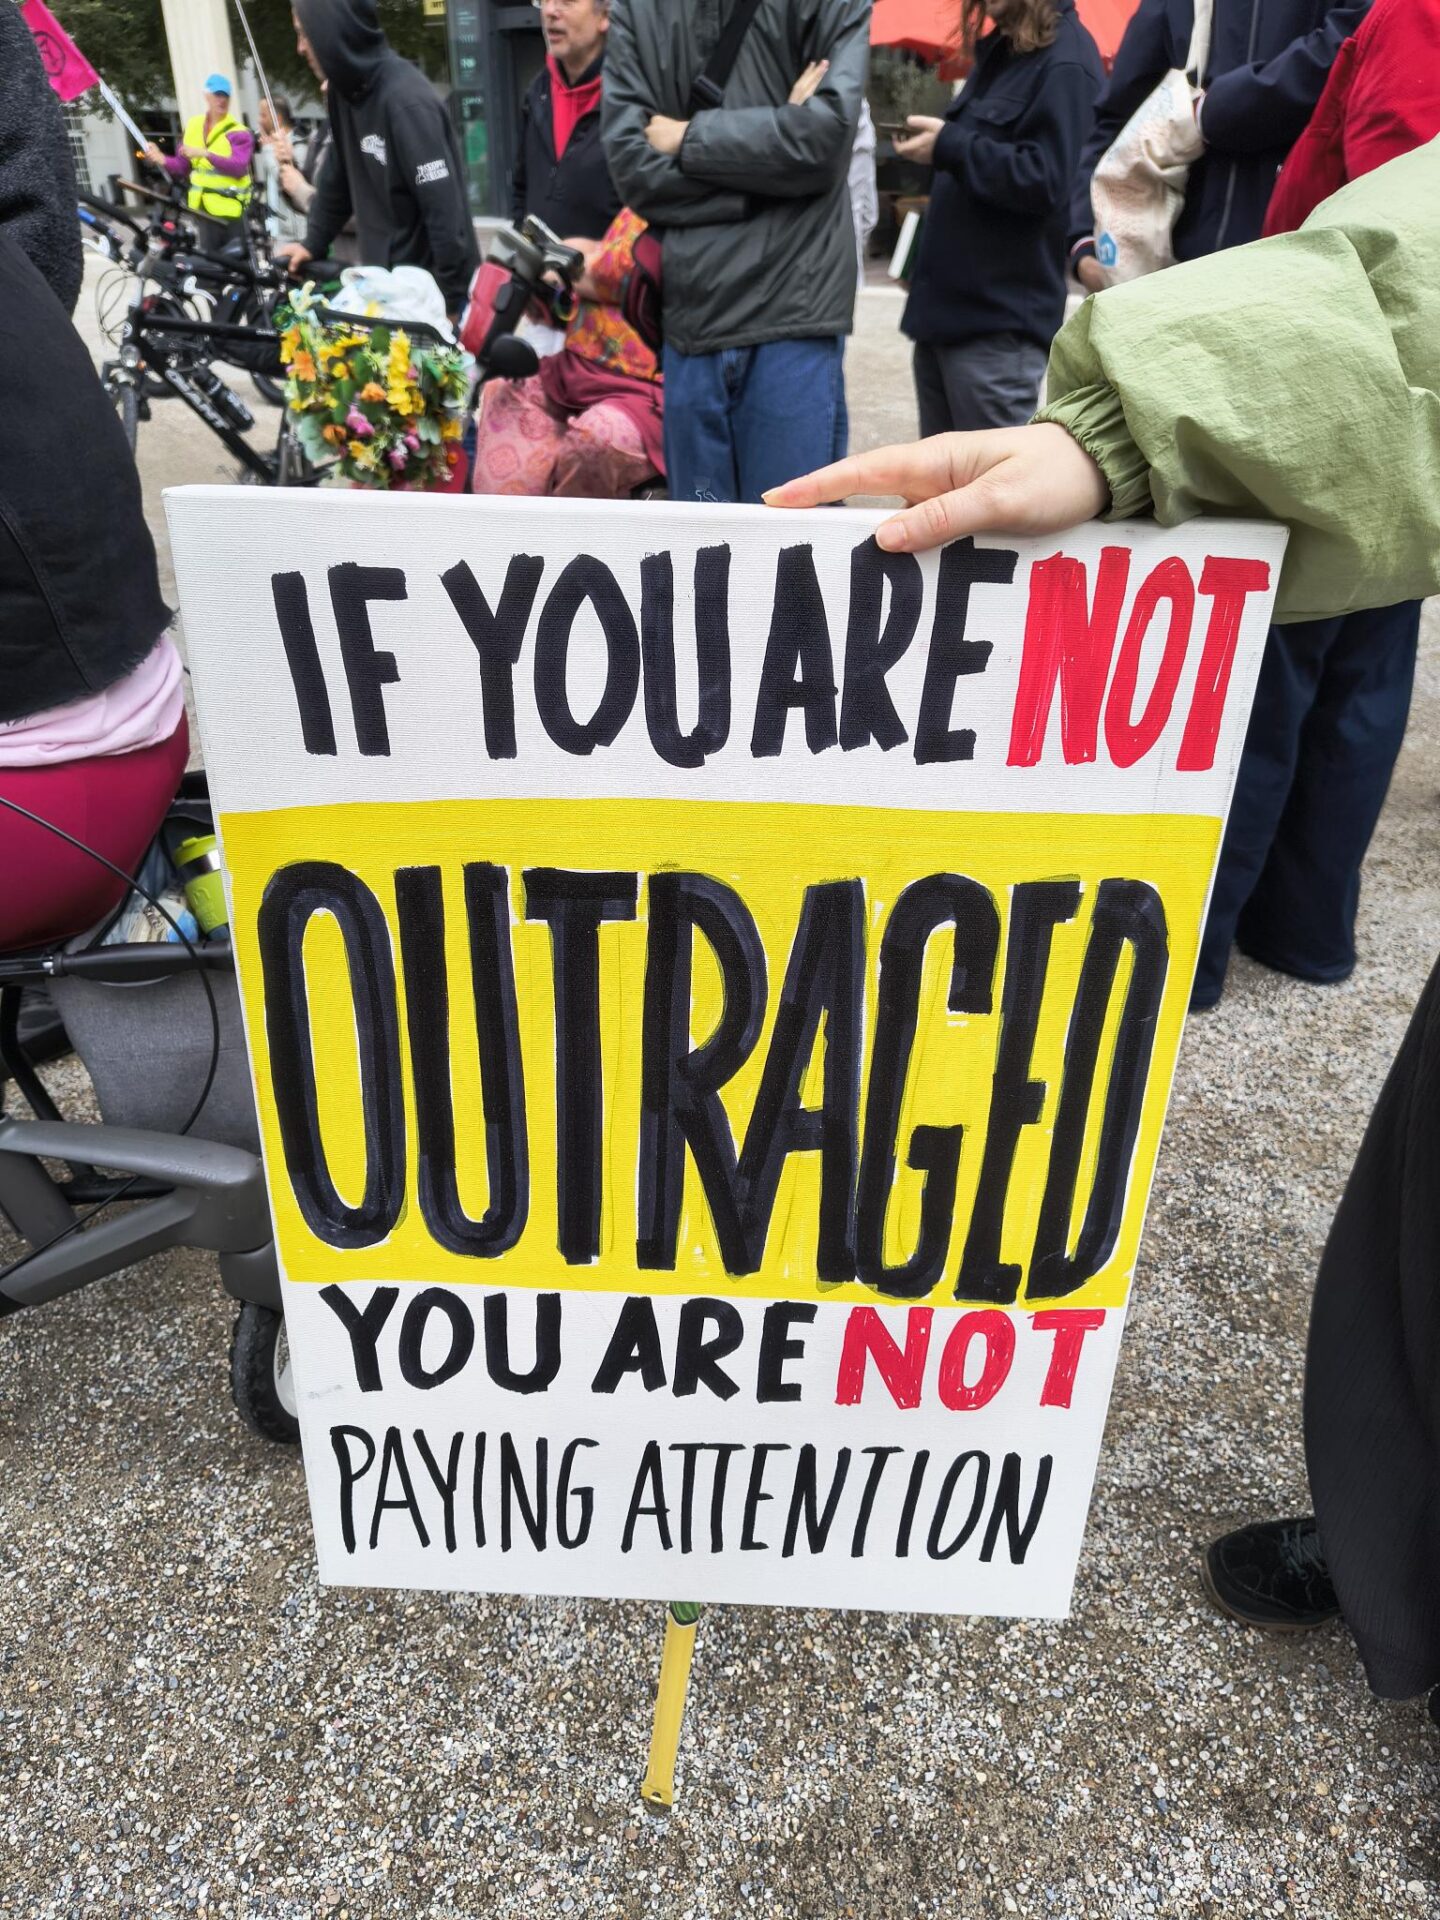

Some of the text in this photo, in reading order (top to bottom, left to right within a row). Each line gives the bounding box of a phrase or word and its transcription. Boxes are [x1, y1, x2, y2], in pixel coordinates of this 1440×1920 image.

[271, 534, 1270, 773] IF YOU ARE NOT
[257, 860, 1170, 1302] OUTRAGED
[318, 1284, 1107, 1411] YOU ARE NOT
[330, 1425, 1054, 1564] PAYING ATTENTION
